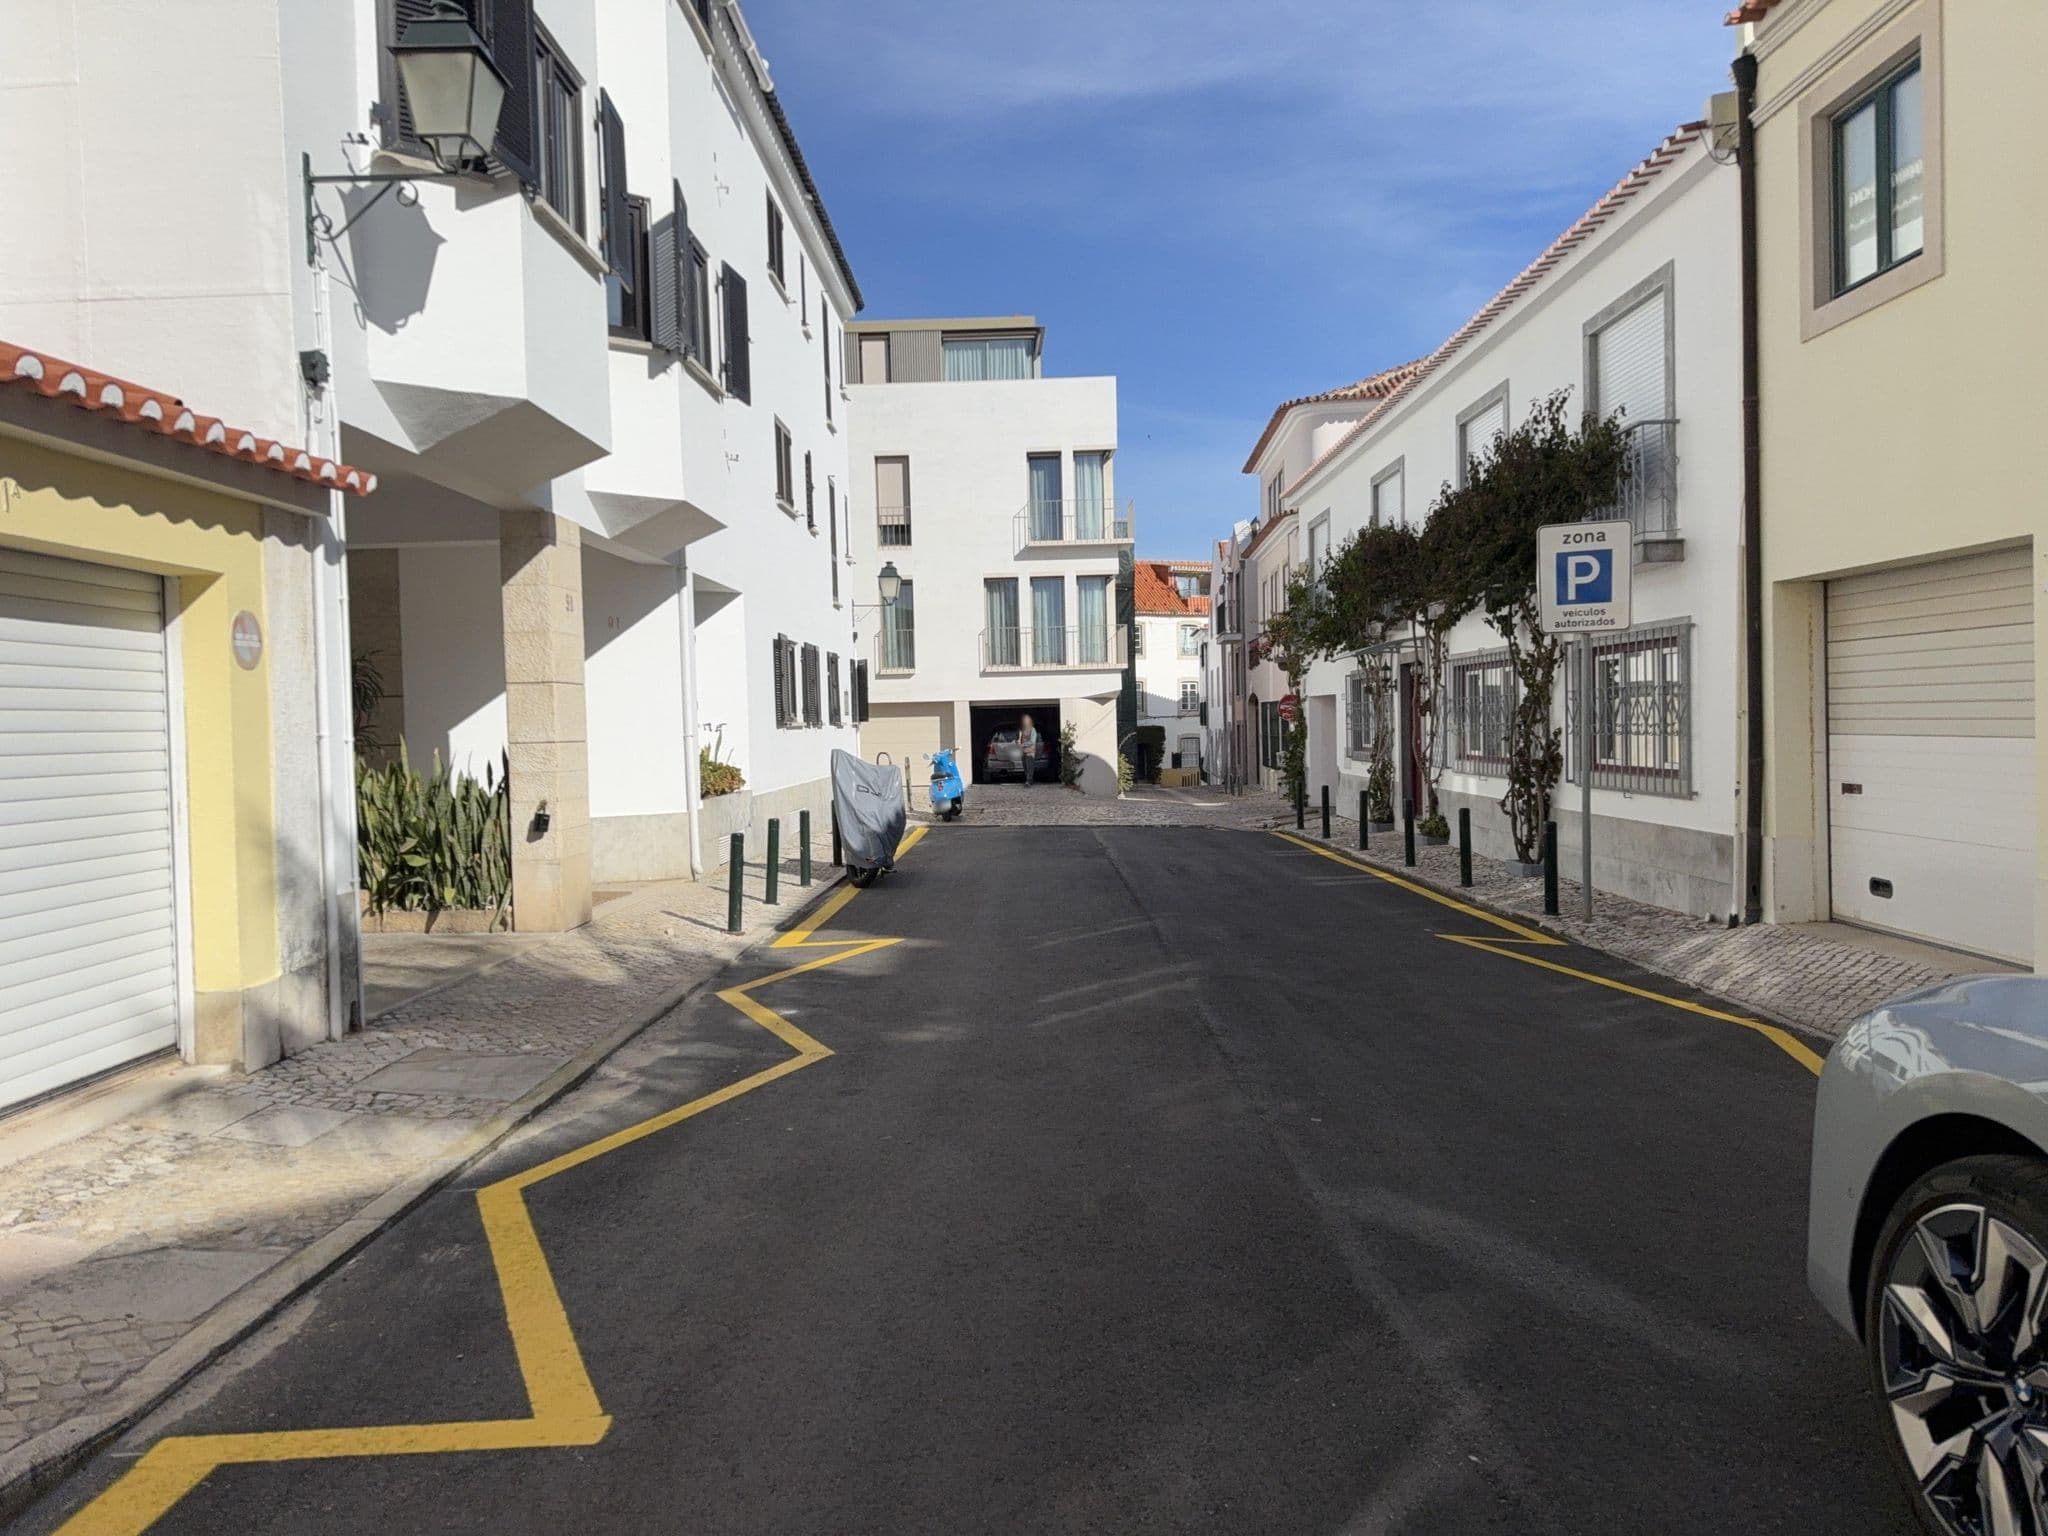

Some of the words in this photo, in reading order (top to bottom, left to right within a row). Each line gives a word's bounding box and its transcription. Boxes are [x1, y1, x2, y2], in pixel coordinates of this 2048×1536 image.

[1562, 531, 1606, 545] zona
[1567, 555, 1601, 601] P
[1554, 617, 1616, 629] autorizados
